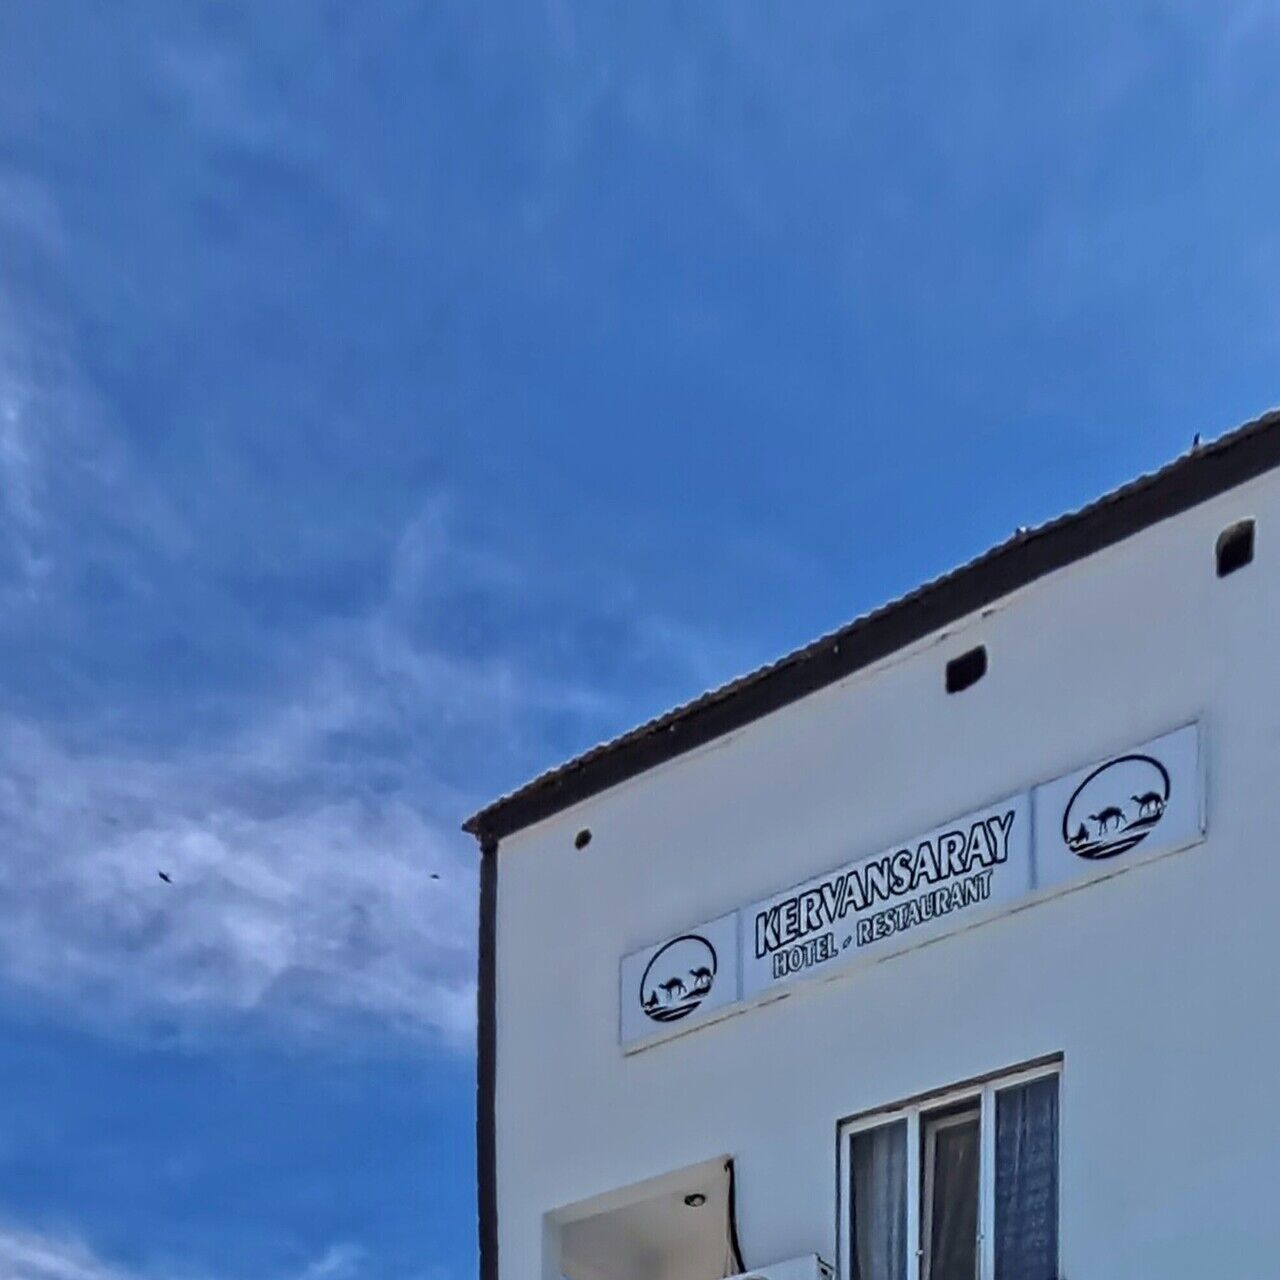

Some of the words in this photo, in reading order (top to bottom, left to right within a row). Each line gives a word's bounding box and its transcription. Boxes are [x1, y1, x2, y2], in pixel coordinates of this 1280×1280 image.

[755, 811, 1016, 959] KERVANSARAY
[773, 932, 839, 979] HOTEL
[856, 868, 993, 947] RESTAURANT
